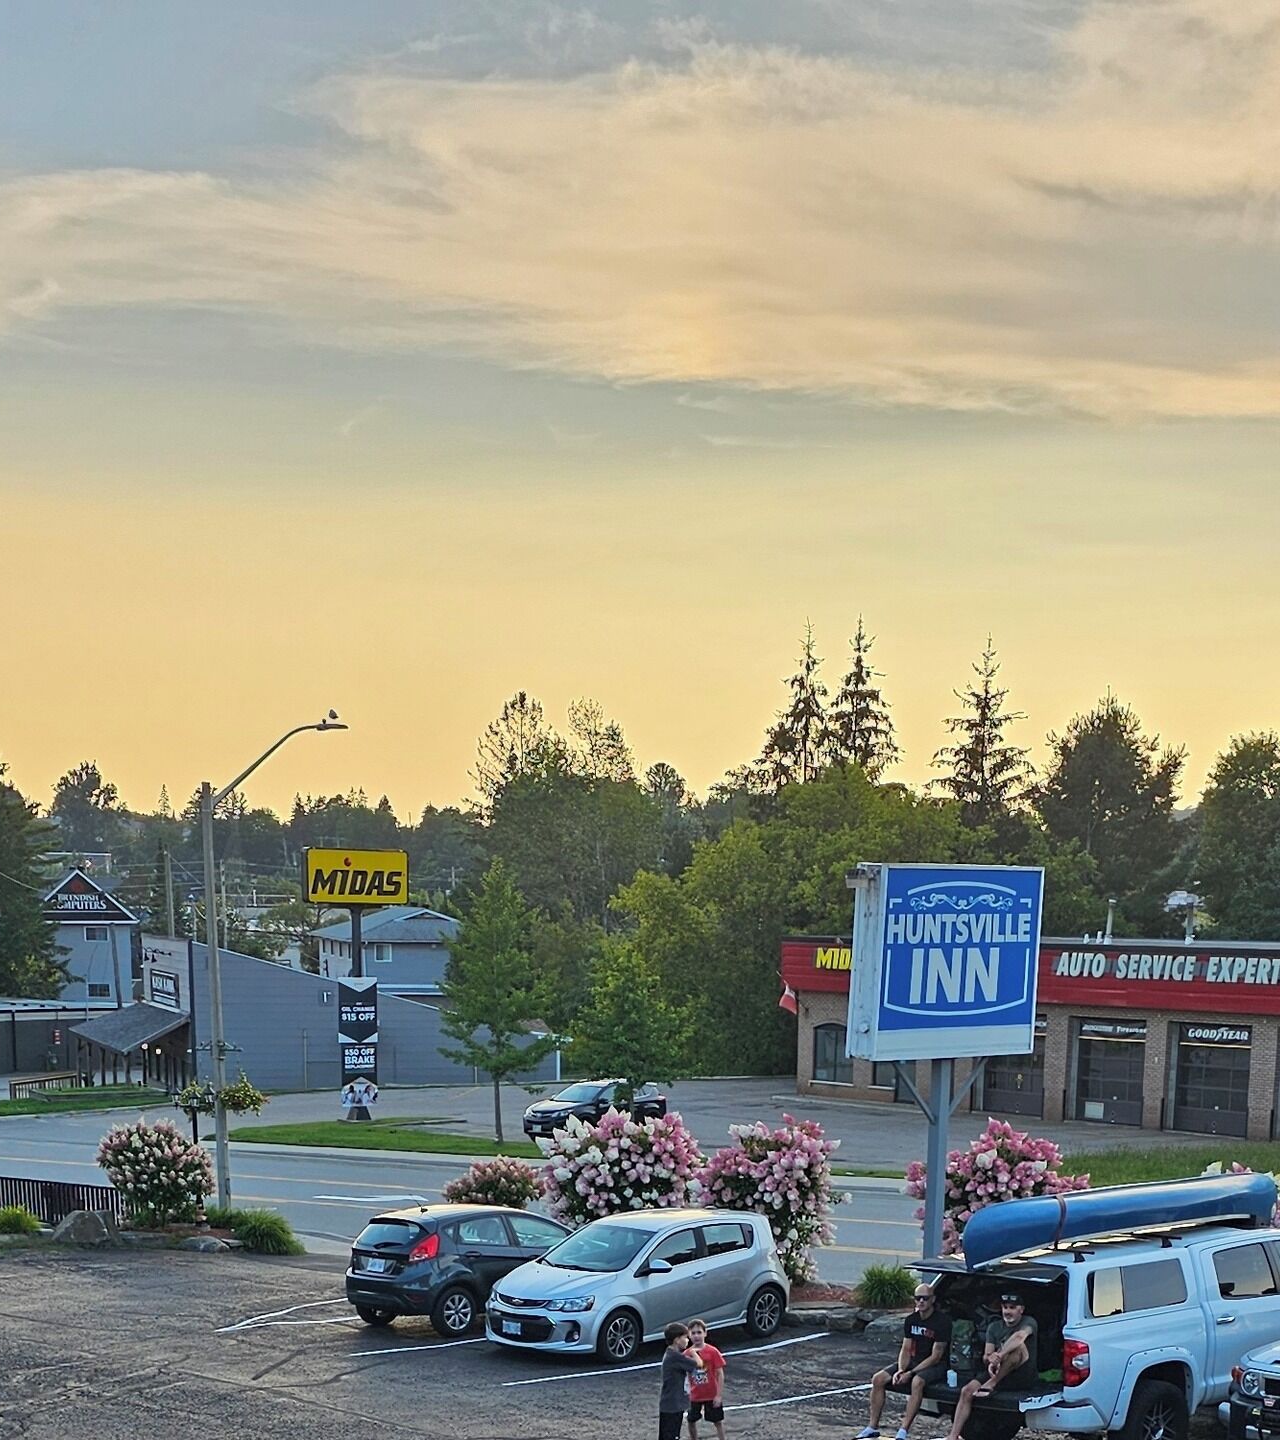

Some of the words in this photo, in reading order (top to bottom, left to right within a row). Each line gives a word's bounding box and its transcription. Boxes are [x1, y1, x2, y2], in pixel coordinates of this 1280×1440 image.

[311, 860, 403, 897] MIDAS
[886, 912, 1032, 945] HUNTSVILLE
[816, 947, 851, 970] MID
[1056, 952, 1106, 978] AUTO
[1115, 954, 1197, 982] SERVICE
[909, 947, 1000, 1005] INN
[341, 1013, 357, 1021] $15
[358, 1013, 376, 1021] OFF
[1188, 1027, 1249, 1041] GOODYEAR
[344, 1056, 376, 1065] BRAKE
[360, 1048, 375, 1056] OFF
